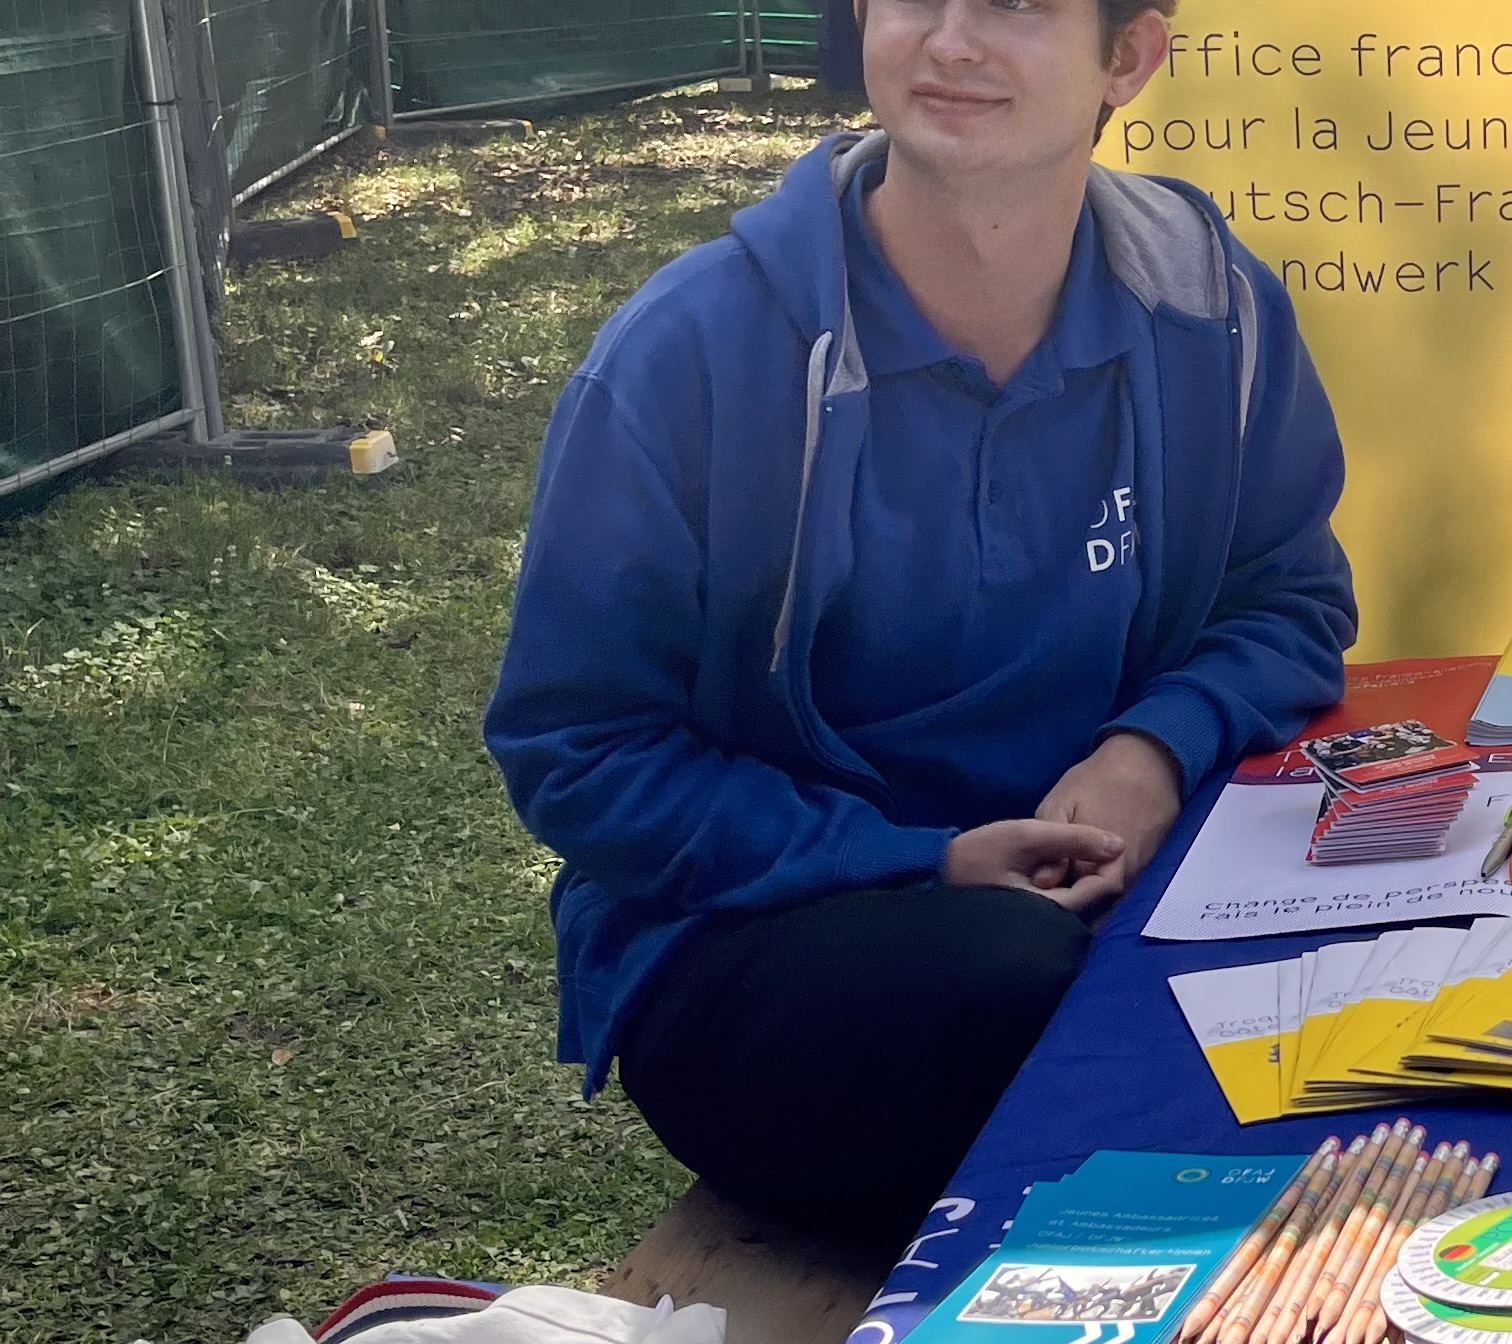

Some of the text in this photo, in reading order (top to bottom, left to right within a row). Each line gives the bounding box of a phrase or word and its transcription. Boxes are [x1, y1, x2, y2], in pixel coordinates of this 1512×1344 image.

[1166, 32, 1322, 78] ffice
[1122, 110, 1265, 163] pour
[1293, 107, 1339, 152] la
[1282, 251, 1495, 294] ndwerk
[1086, 529, 1136, 572] DF
[1205, 896, 1317, 912] Change
[1332, 892, 1370, 902] de
[1315, 900, 1391, 914] plein
[1406, 891, 1443, 904] de
[1221, 1174, 1272, 1184] DFJW
[1228, 1167, 1276, 1176] OFAJ
